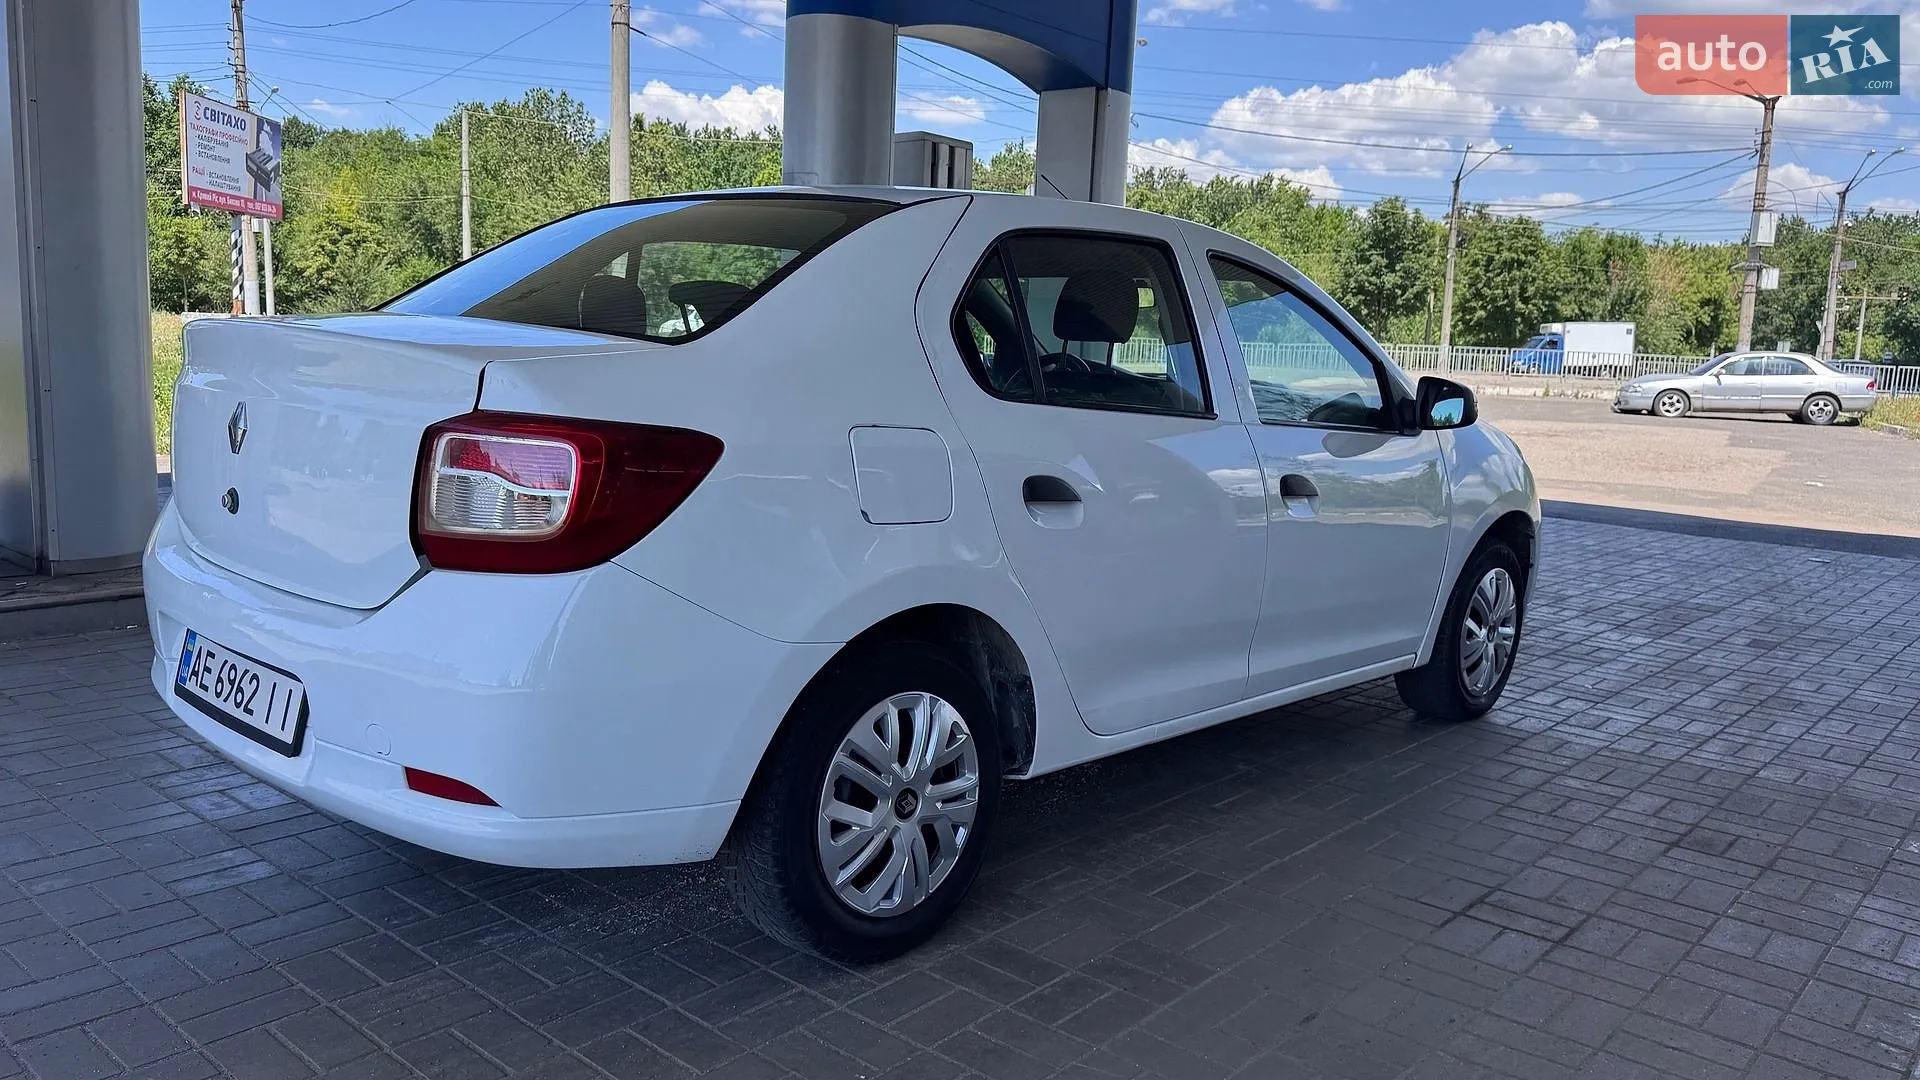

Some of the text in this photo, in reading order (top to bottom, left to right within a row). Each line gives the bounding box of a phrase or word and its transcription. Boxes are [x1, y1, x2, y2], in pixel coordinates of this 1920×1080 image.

[203, 106, 247, 132] СВІТАХО
[188, 645, 216, 693] AE
[214, 659, 260, 717] 6962
